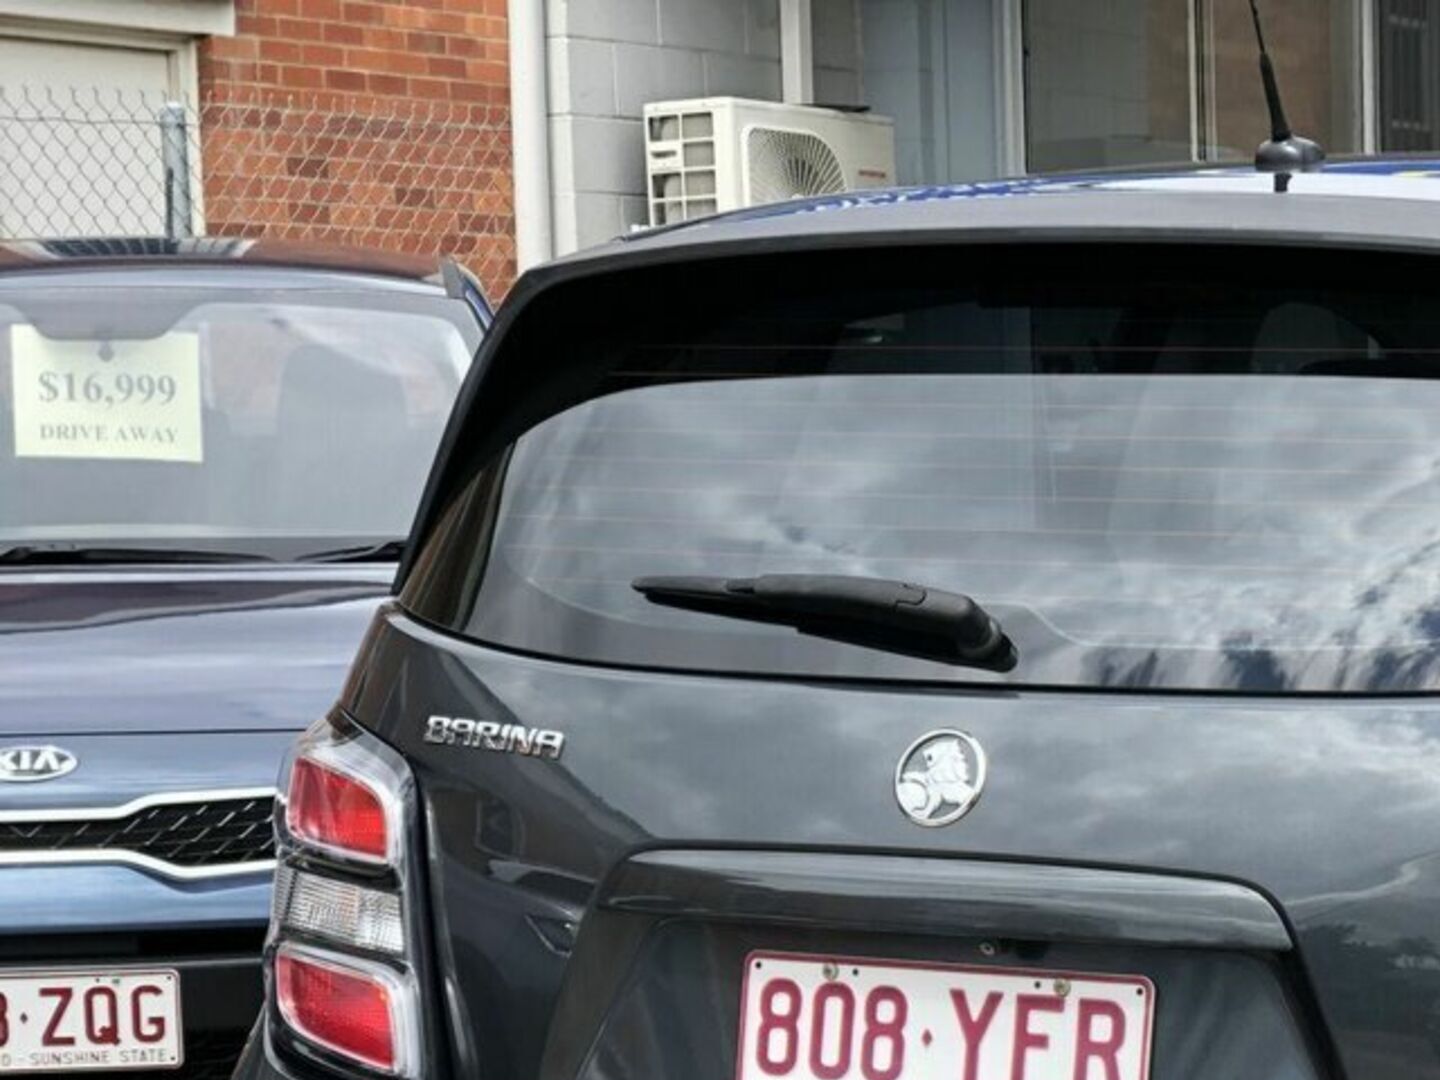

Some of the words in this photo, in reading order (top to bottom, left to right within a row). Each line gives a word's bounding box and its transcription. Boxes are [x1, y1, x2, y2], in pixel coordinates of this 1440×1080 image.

[37, 370, 177, 410] $16,999
[40, 424, 109, 442] DRIVE
[115, 427, 178, 444] AWAY
[424, 714, 566, 761] BARINA
[29, 1051, 111, 1066] SUNSHINE
[119, 1049, 167, 1064] STATE
